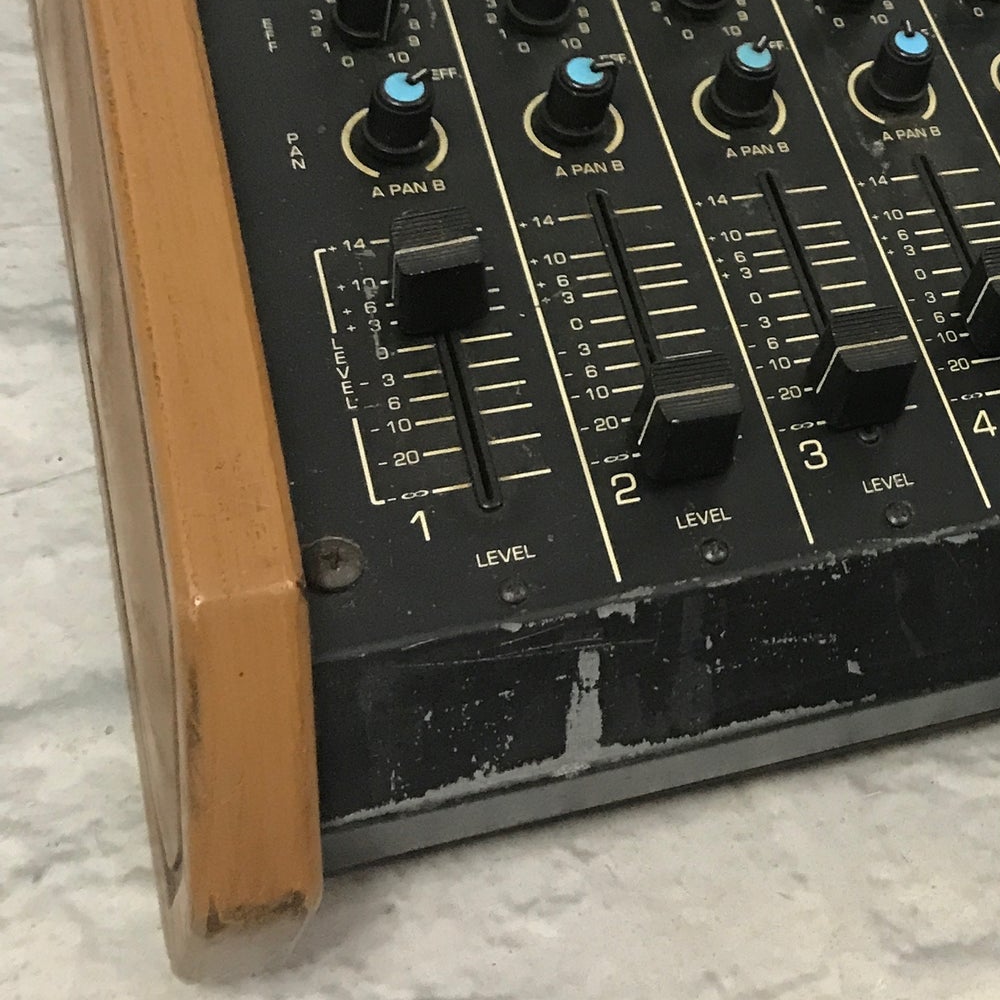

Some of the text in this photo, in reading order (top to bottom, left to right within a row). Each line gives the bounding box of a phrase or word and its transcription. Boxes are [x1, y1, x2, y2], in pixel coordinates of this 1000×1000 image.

[342, 56, 354, 67] 0
[388, 52, 409, 63] 10
[881, 126, 941, 143] A PAN B
[286, 133, 307, 171] PAN
[727, 142, 789, 158] A PAN B
[556, 160, 624, 177] A PAN B
[869, 175, 888, 186] 14
[372, 179, 445, 198] A PAN B
[708, 194, 728, 206] 14
[533, 215, 554, 227] 14
[883, 209, 903, 220] 10
[721, 230, 742, 242] 10
[897, 230, 909, 240] 6
[343, 238, 368, 253] 14
[904, 245, 915, 255] 3
[544, 252, 566, 265] 10
[734, 251, 746, 263] 6
[740, 267, 752, 278] 3
[914, 269, 926, 280] 0
[352, 278, 378, 292] 10
[557, 275, 569, 287] 6
[562, 292, 574, 304] 3
[750, 292, 762, 304] 0
[925, 292, 936, 303] 3
[364, 301, 377, 314] 6
[758, 316, 771, 328] 3
[933, 312, 945, 323] 6
[368, 317, 381, 333] 3
[767, 337, 779, 349] 6
[937, 331, 957, 343] 10
[376, 345, 389, 360] 0
[578, 343, 591, 356] 3
[769, 357, 791, 370] 10
[948, 358, 969, 372] 20
[330, 337, 359, 410] LEVEL
[585, 365, 597, 378] 6
[382, 374, 395, 386] 3
[586, 386, 609, 400] 10
[778, 386, 801, 400] 20
[388, 397, 400, 410] 6
[387, 419, 411, 433] 10
[594, 416, 618, 431] 20
[973, 410, 997, 436] 4
[393, 450, 419, 466] 20
[799, 440, 827, 469] 3
[611, 473, 641, 505] 2
[862, 473, 914, 493] LEVEL
[676, 508, 732, 529] LEVEL
[410, 511, 430, 541] 1
[476, 545, 536, 567] LEVEL
